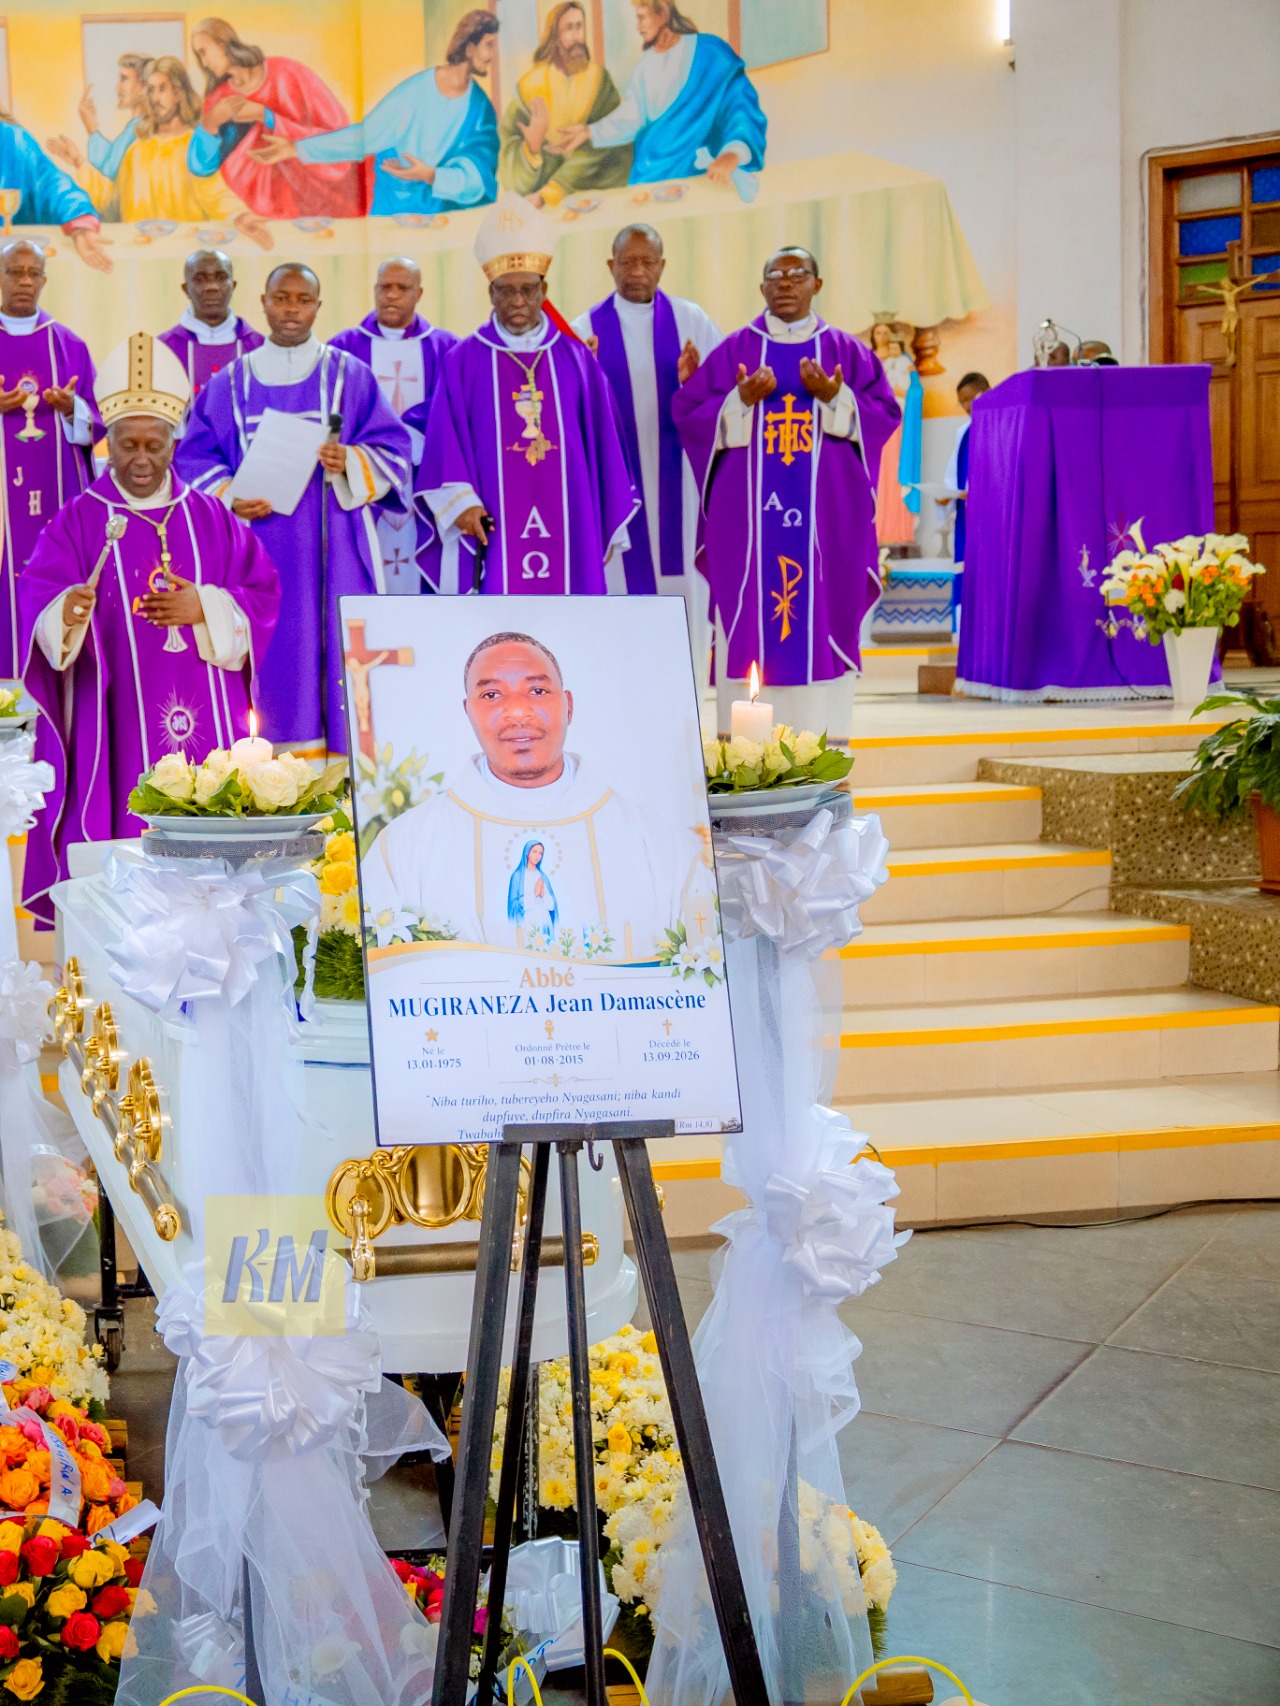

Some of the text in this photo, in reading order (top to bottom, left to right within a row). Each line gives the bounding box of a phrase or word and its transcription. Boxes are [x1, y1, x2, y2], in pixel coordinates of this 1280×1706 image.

[519, 966, 575, 989] Abbé
[388, 990, 706, 1018] MUGIRANEZA Jean Damascène
[422, 1046, 445, 1055] Né le
[515, 1043, 553, 1053] Ordonné
[583, 1042, 591, 1050] le
[648, 1039, 691, 1048] Décédé le
[643, 1050, 700, 1062] 13.09.2026
[461, 1095, 497, 1106] turiho,
[501, 1093, 559, 1107] tubereyeho
[624, 1089, 648, 1100] niba
[651, 1088, 681, 1100] kandi
[531, 1108, 571, 1123] dupfira
[575, 1106, 633, 1121] Nyagasani.
